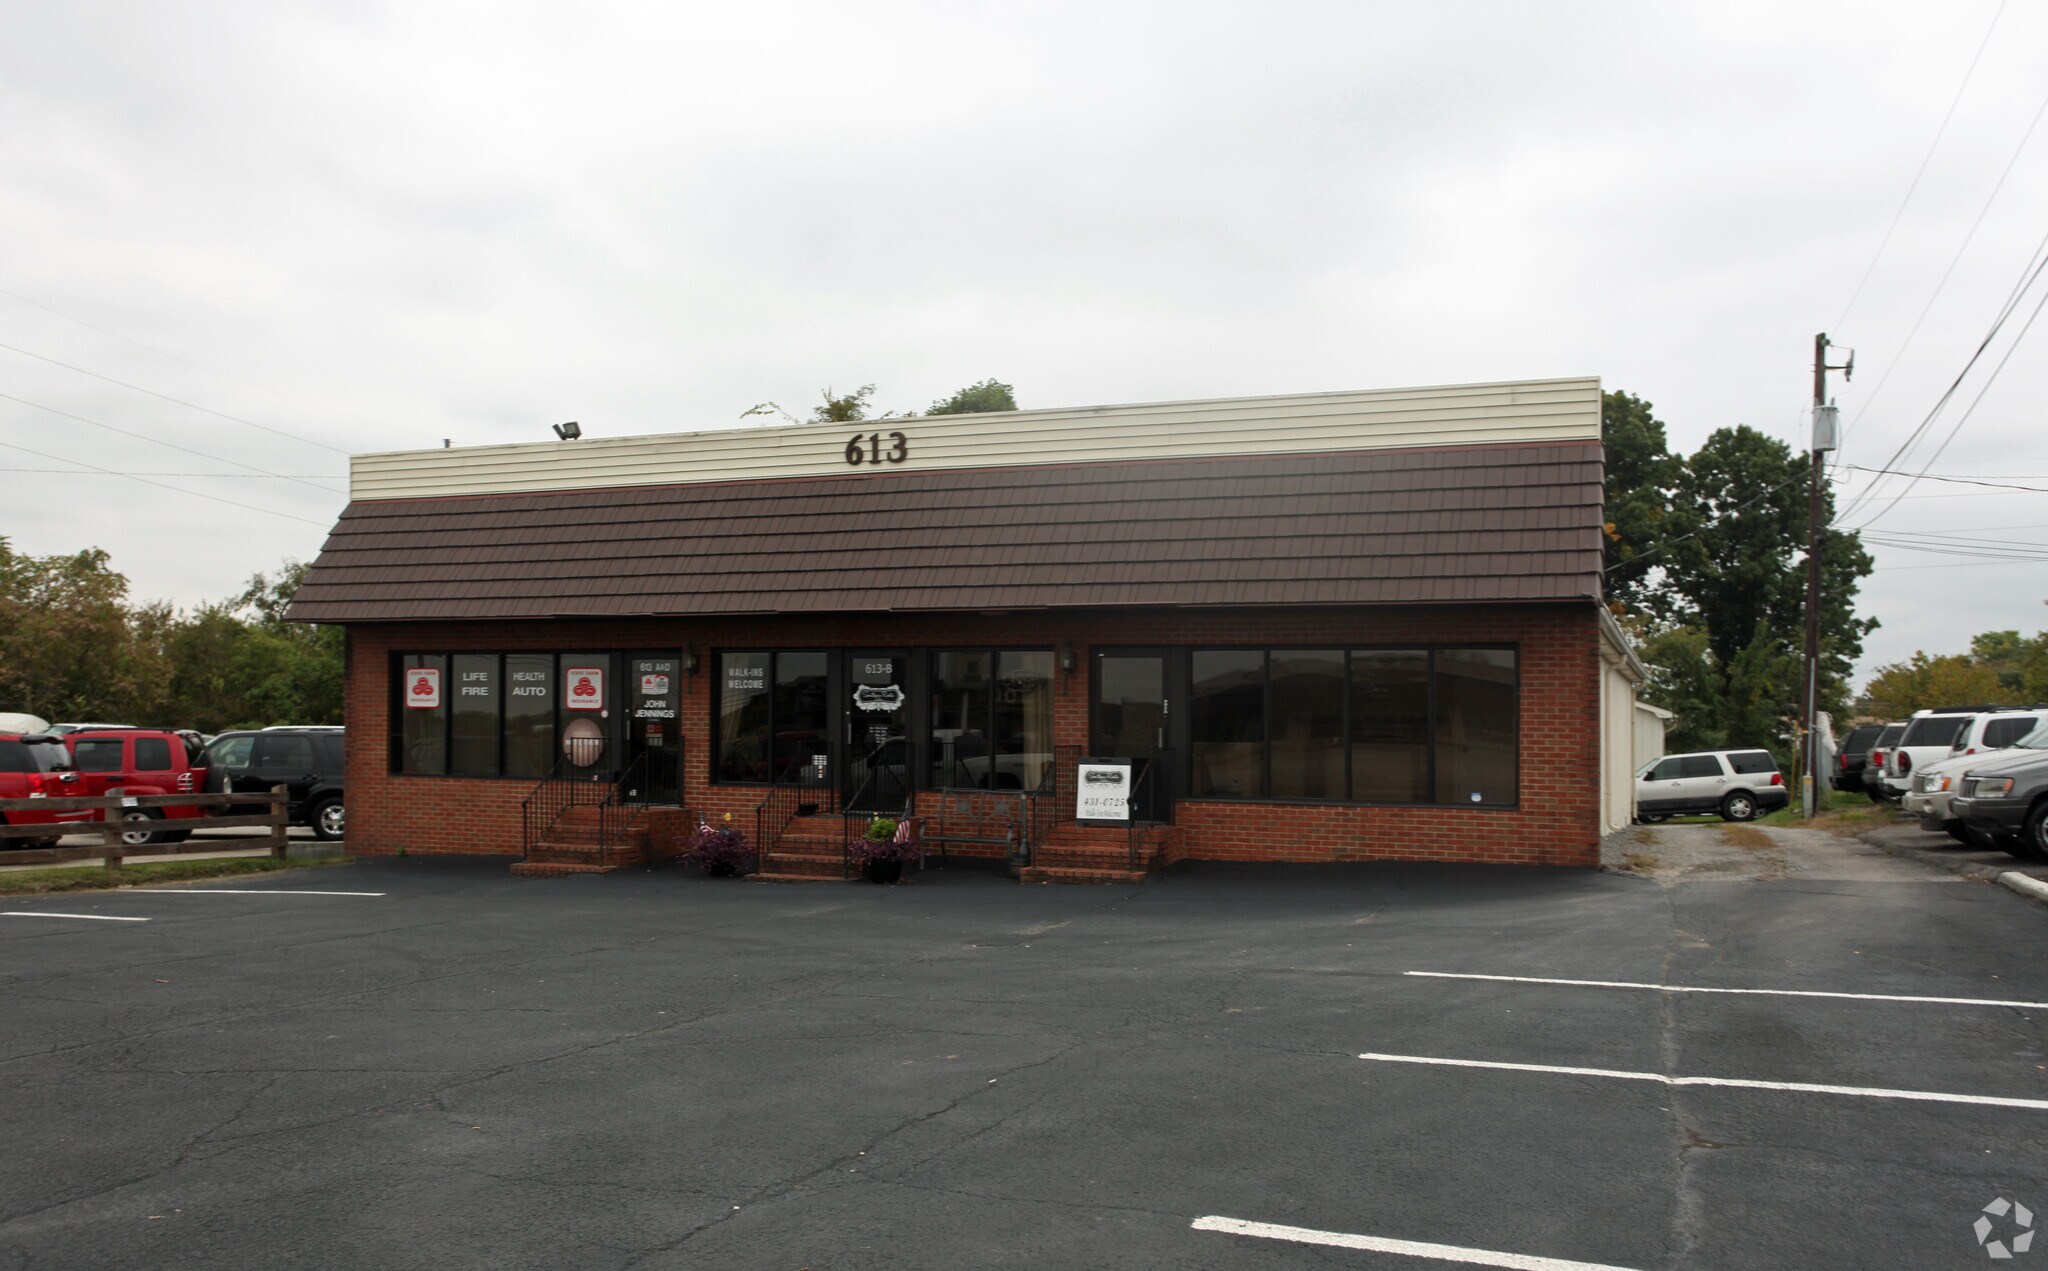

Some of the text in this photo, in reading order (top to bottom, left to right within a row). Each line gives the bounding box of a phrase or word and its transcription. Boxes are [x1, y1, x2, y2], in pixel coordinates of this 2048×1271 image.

[845, 431, 908, 466] 613
[639, 662, 653, 672] 613
[727, 667, 764, 677] WALK-INS
[865, 663, 893, 674] 613-B
[462, 672, 488, 681] LIFE
[512, 671, 545, 681] HEALTH
[727, 679, 764, 689] WELCOME
[461, 686, 489, 696] FIRE
[512, 686, 547, 696] AUTO
[643, 700, 667, 708] JOHN
[634, 709, 675, 718] JENNINGS
